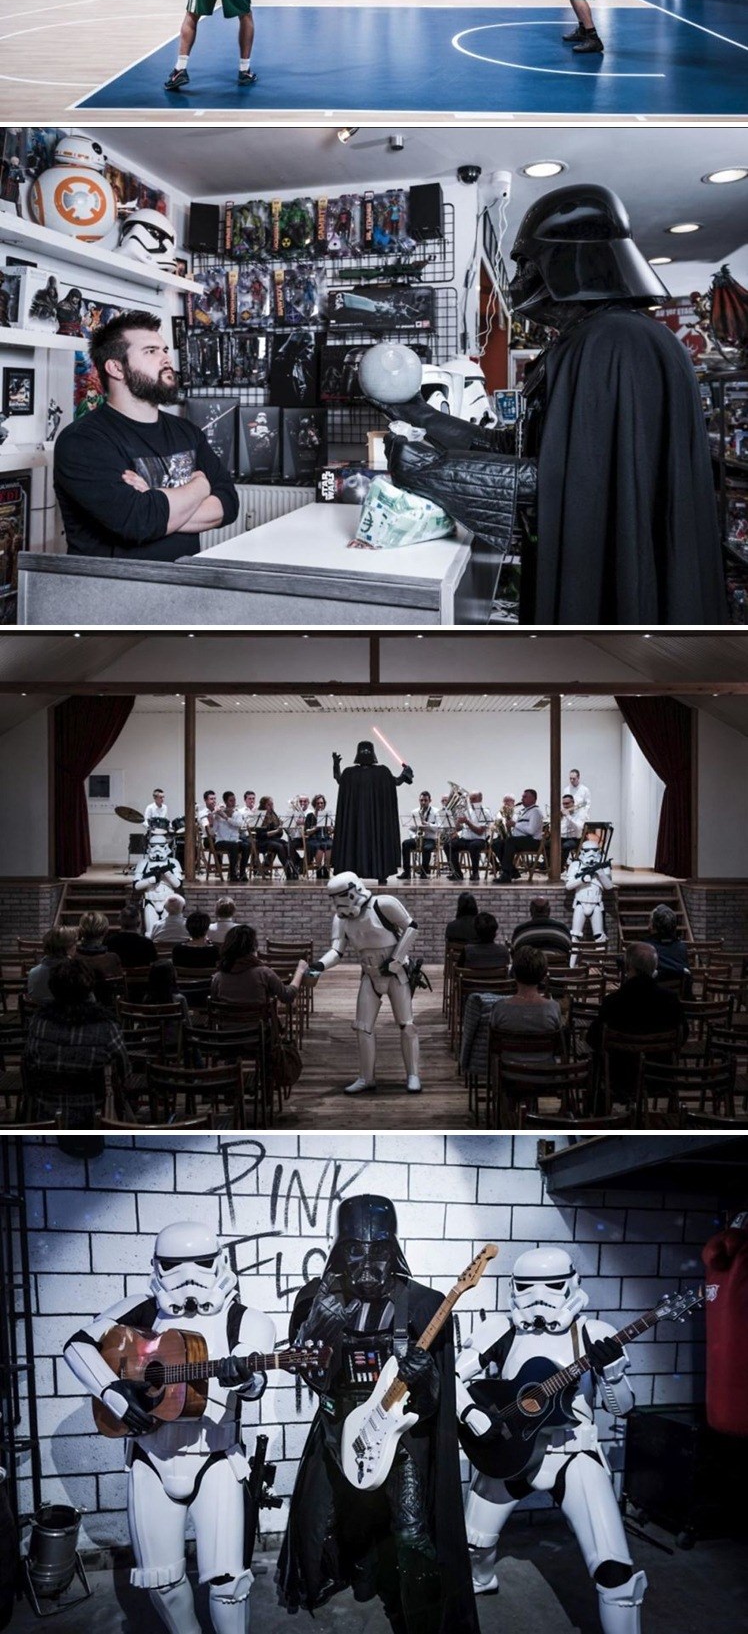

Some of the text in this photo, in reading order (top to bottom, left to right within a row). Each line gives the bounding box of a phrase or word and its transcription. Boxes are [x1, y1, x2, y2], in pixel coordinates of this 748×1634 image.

[321, 471, 335, 500] STAR WARS
[205, 1139, 370, 1249] PINK
